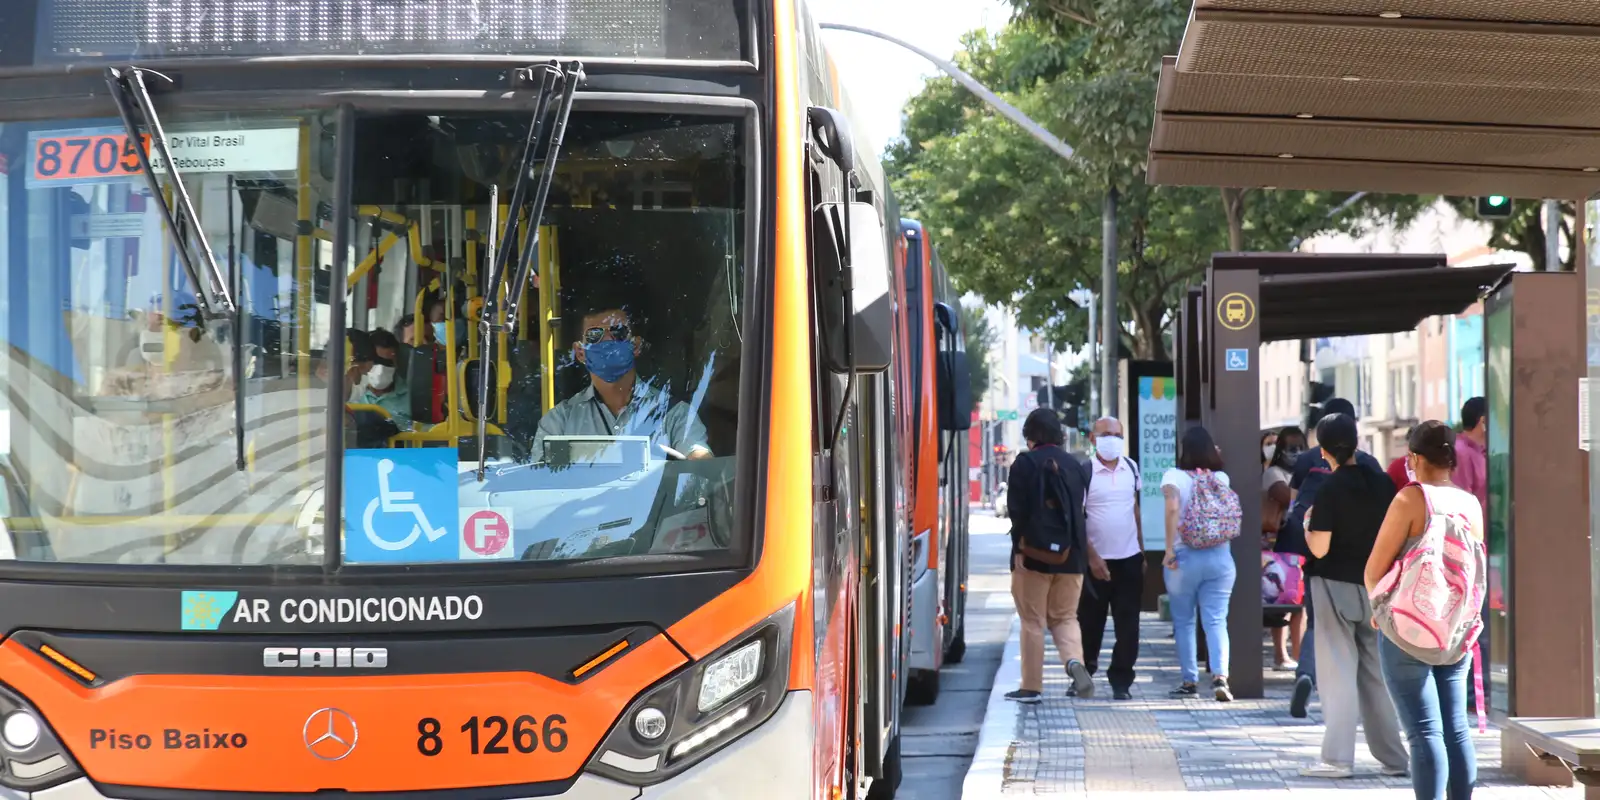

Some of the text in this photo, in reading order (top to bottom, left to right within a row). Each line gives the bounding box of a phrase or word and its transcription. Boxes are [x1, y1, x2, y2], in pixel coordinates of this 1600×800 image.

[172, 137, 183, 148] Dr
[186, 136, 210, 148] Vital
[213, 135, 245, 147] Brasil
[37, 137, 145, 176] 8705
[173, 157, 225, 170] Rebouças
[1144, 413, 1177, 425] COMP
[1144, 428, 1177, 439] DO BA
[1153, 441, 1176, 453] ÓTI
[474, 518, 498, 549] F
[233, 594, 483, 623] AR CONDICIONADO
[263, 647, 388, 668] CAIO
[90, 728, 248, 750] Piso Baixo
[417, 713, 569, 757] 8 1266
